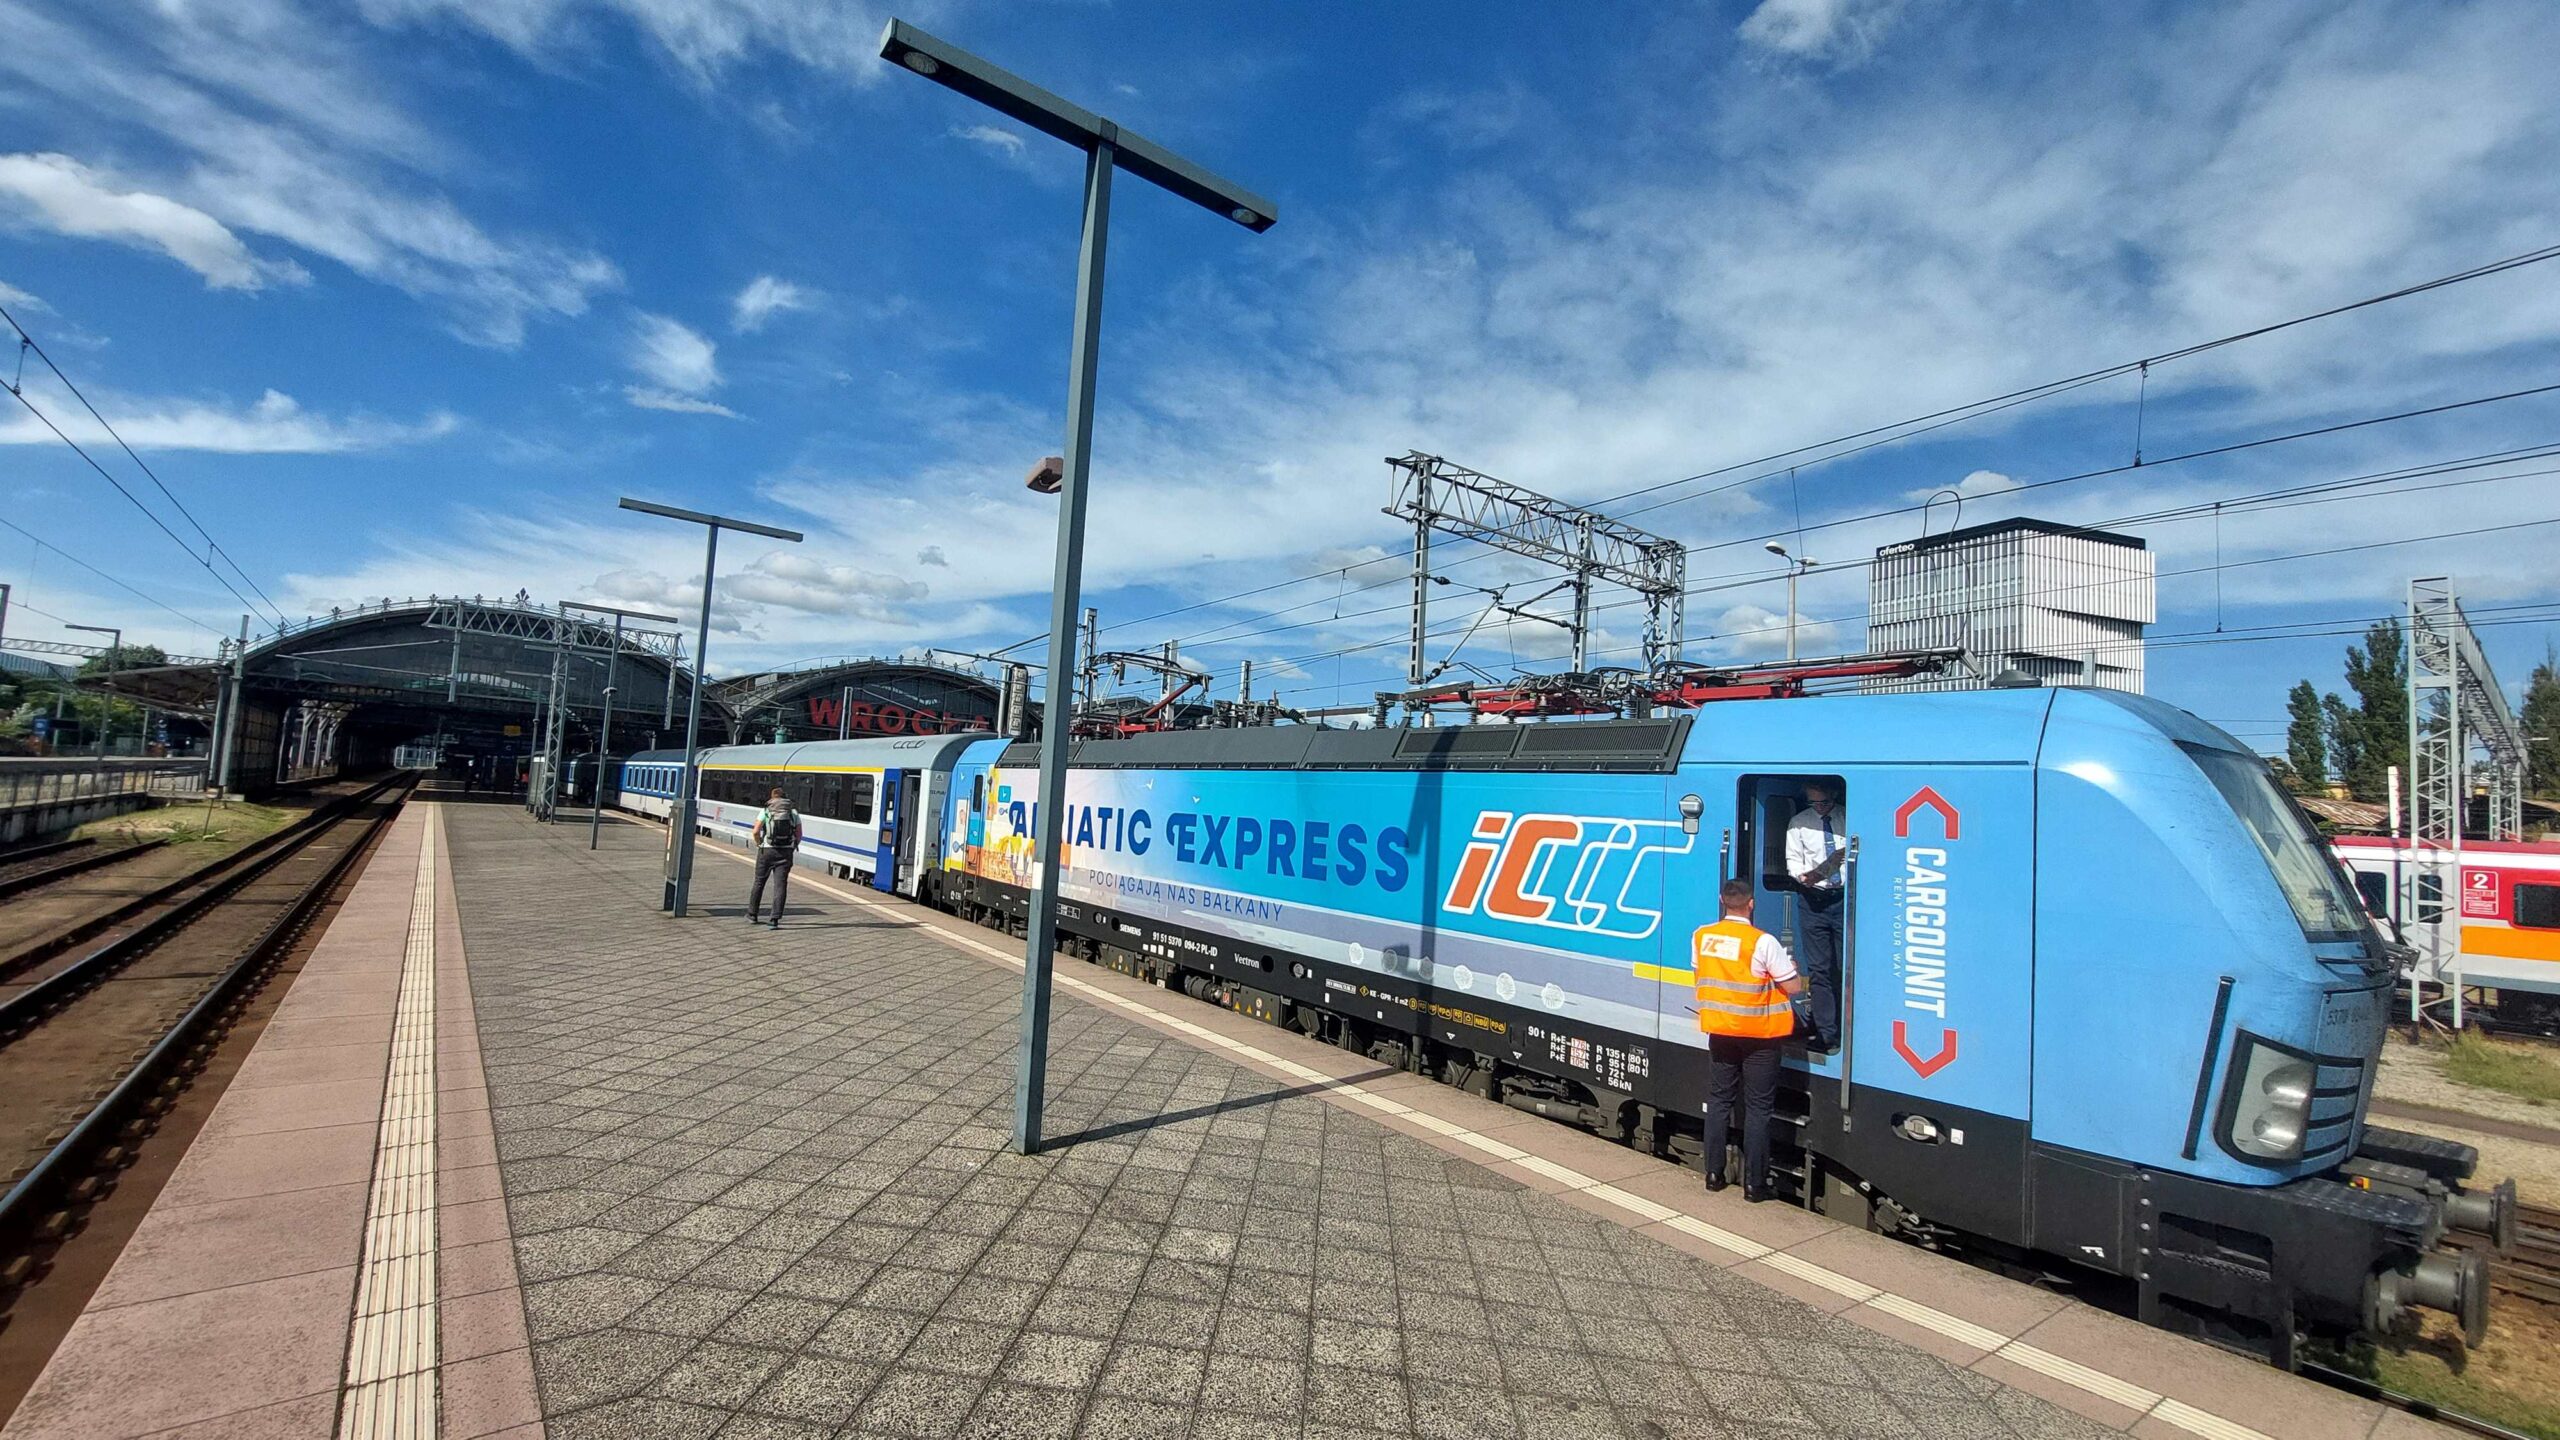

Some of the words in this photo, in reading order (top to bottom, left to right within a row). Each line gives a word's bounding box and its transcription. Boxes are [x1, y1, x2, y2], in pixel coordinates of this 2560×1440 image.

[1879, 543, 1915, 557] oferteo
[1008, 800, 1153, 856] AIATIC
[1165, 812, 1411, 893] EXPRESS
[2472, 873, 2489, 889] 2
[1088, 869, 1161, 903] POCIĄGAJĄ
[1167, 884, 1196, 905] NAS
[1203, 890, 1283, 922] BAŁKANY
[1893, 876, 1902, 907] RENT
[1119, 923, 1142, 937] SIEMENS
[1893, 914, 1902, 946] YOUR
[1904, 847, 1947, 1019] CARGOUNIT
[1152, 931, 1160, 941] 91
[1160, 933, 1167, 943] 51
[1168, 935, 1182, 947] 5370
[1201, 943, 1218, 957] PL-ID
[1233, 952, 1260, 969] Vectron
[1892, 952, 1902, 978] WAY
[1528, 1025, 1539, 1037] 90
[1540, 1029, 1545, 1039] t
[1550, 1051, 1565, 1063] P+E
[1595, 1054, 1602, 1063] P
[1596, 1045, 1602, 1055] R
[1605, 1047, 1620, 1059] 135
[1595, 1064, 1603, 1074] G
